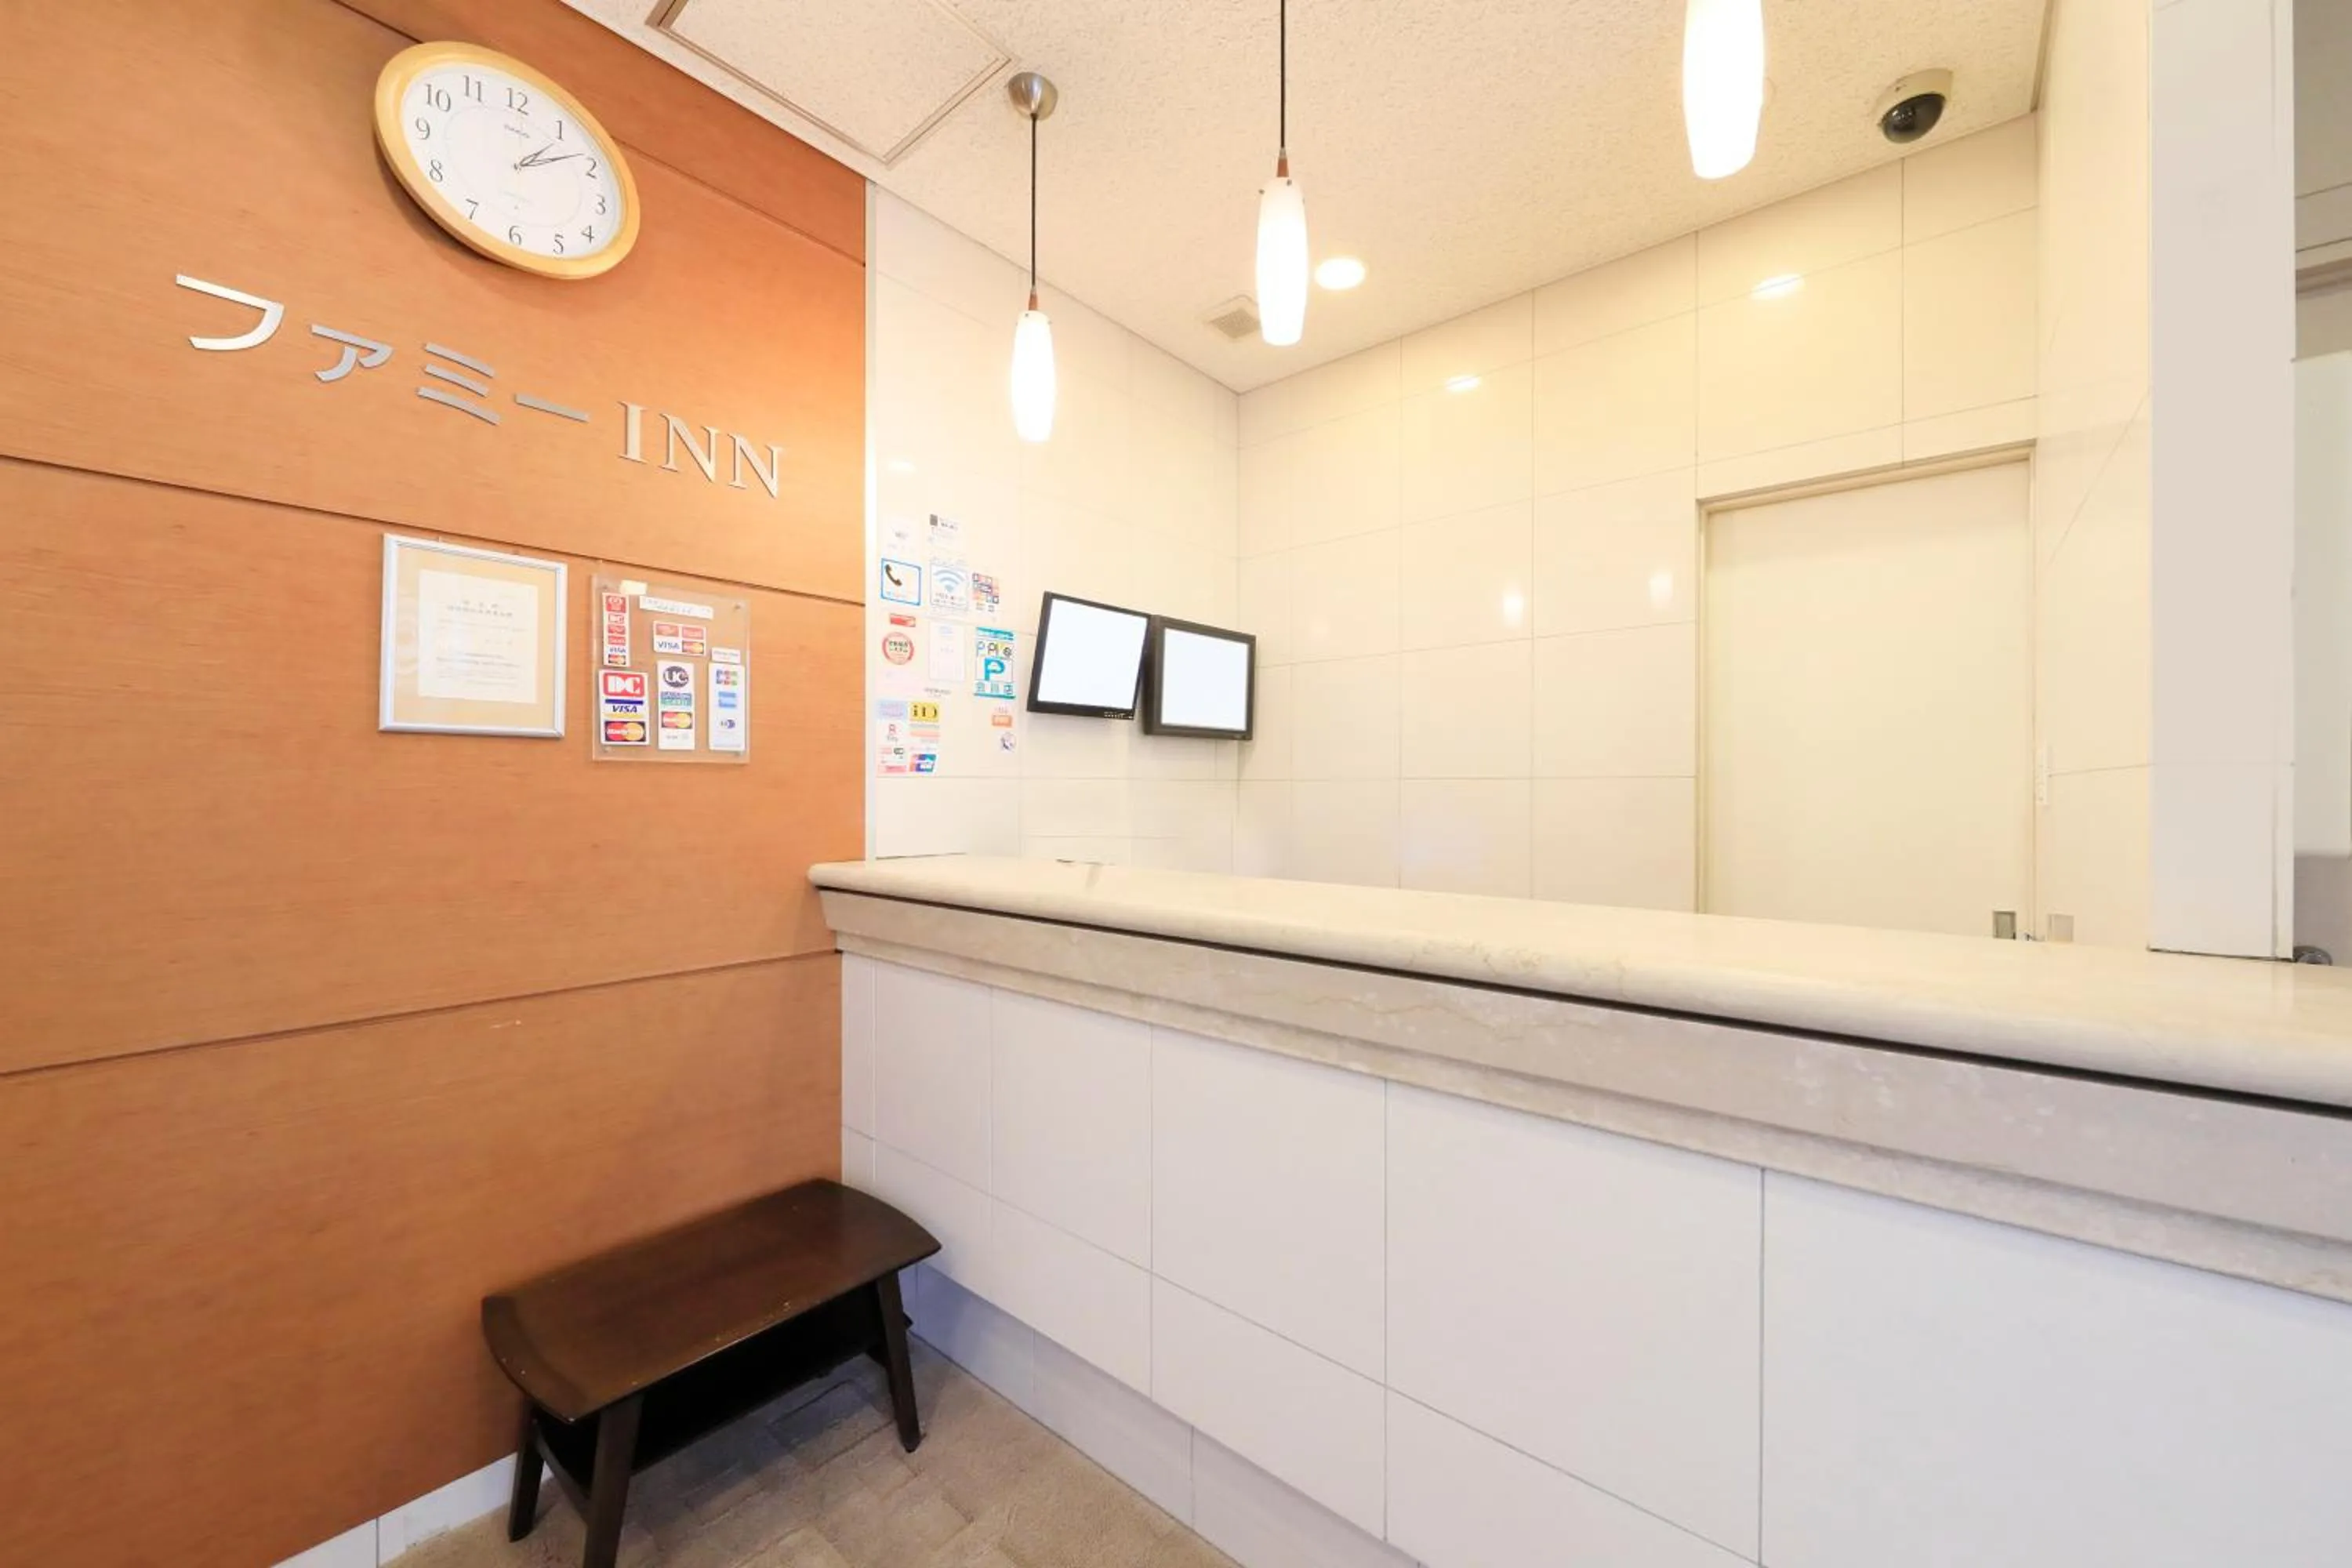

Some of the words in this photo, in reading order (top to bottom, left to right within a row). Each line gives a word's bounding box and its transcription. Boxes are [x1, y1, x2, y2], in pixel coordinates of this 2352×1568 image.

[426, 83, 452, 112] 10
[463, 74, 482, 103] 11
[506, 87, 529, 116] 12
[415, 117, 431, 140] 9
[555, 119, 564, 141] 1
[429, 158, 444, 183] 8
[586, 158, 597, 180] 2
[465, 198, 479, 220] 7
[594, 194, 606, 216] 3
[509, 224, 523, 246] 6
[553, 234, 564, 255] 5
[580, 224, 595, 245] 4
[176, 274, 590, 426] ファミー
[617, 400, 784, 499] INN
[659, 640, 681, 650] VISA
[985, 657, 1006, 681] P
[608, 675, 641, 694] DC
